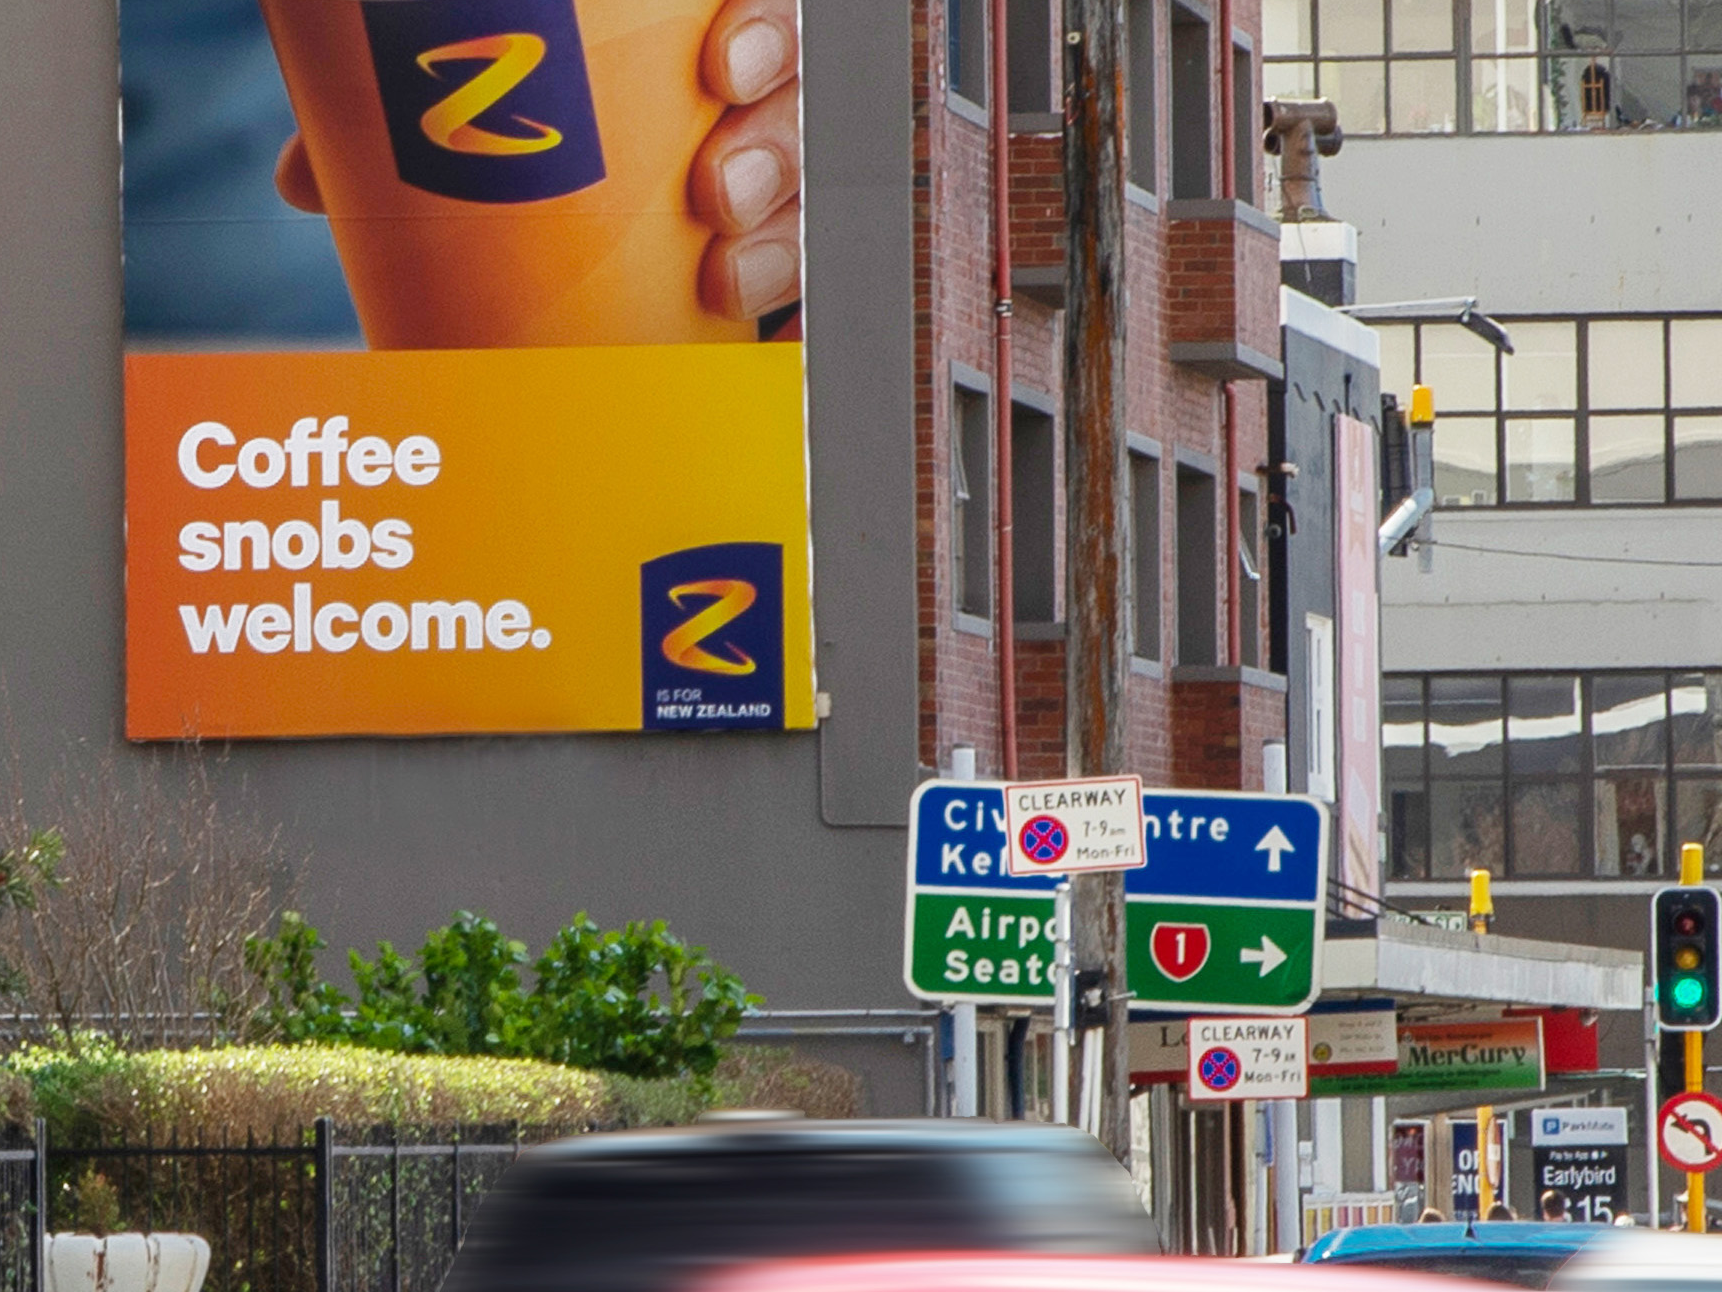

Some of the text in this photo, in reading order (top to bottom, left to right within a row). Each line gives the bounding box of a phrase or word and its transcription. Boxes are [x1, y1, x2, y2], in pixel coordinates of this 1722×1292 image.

[415, 32, 563, 155] Z
[178, 415, 442, 489] Coffee
[178, 499, 414, 572] snobs
[178, 582, 552, 654] welcome.
[662, 579, 757, 676] Z
[656, 688, 703, 702] IS FOR
[656, 703, 771, 719] NEW ZEALAND
[1018, 788, 1127, 812] CLEARWAY
[943, 799, 1229, 842] Civ ntre
[1076, 844, 1136, 860] Mon-Fri
[944, 906, 1057, 949] Airpo
[1175, 931, 1186, 965] 1
[1200, 1024, 1295, 1042] CLEARWAY
[1243, 1071, 1302, 1084] Mon-Fri
[1542, 1165, 1616, 1190] Earlybird
